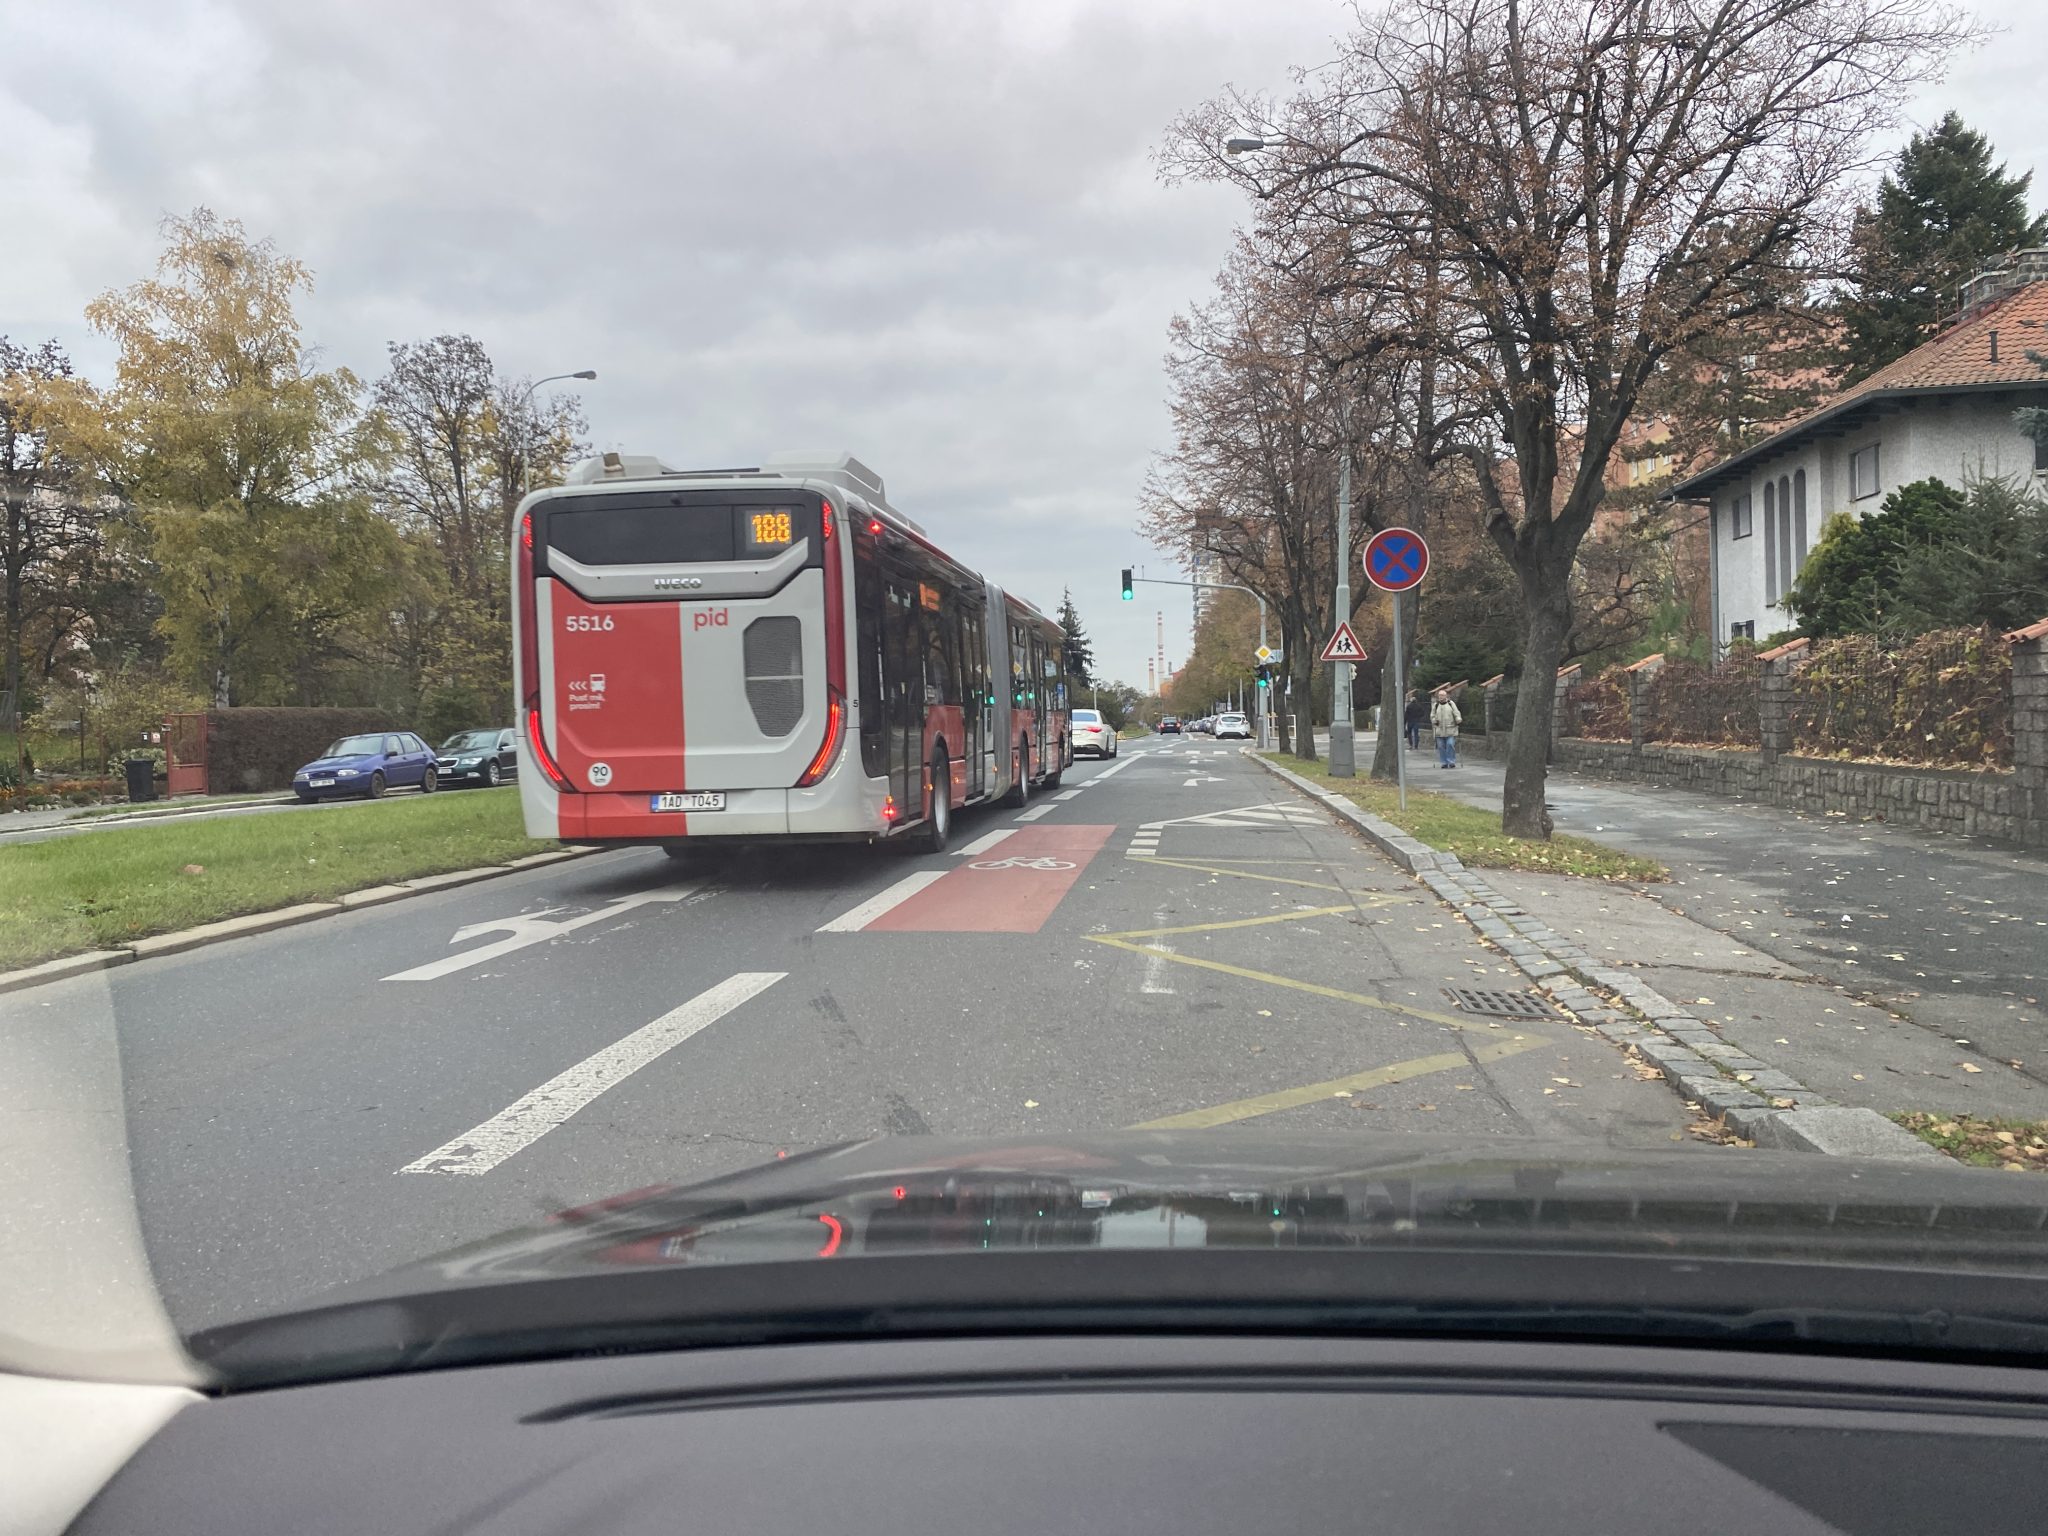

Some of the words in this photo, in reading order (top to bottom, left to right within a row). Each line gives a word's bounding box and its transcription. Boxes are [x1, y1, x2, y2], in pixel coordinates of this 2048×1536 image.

[752, 513, 790, 543] 188
[654, 578, 702, 590] IVECO
[566, 615, 615, 631] 5516
[694, 607, 729, 631] pid
[592, 766, 608, 776] 90
[662, 796, 682, 808] 1AD
